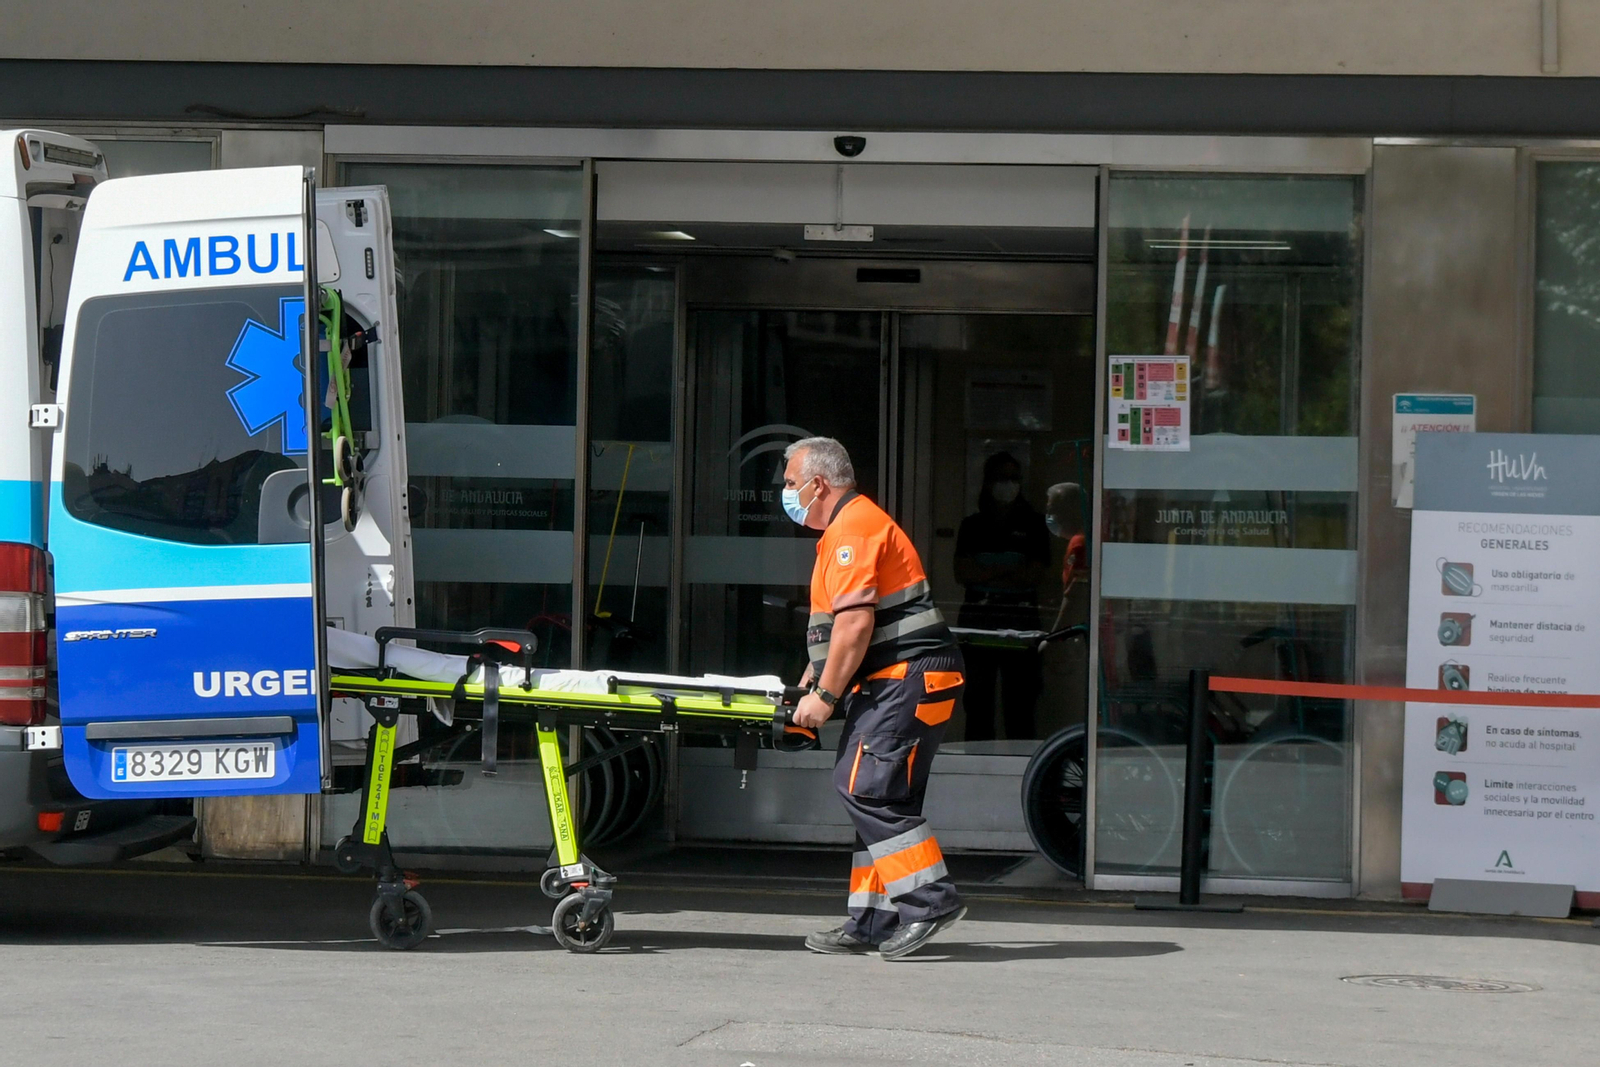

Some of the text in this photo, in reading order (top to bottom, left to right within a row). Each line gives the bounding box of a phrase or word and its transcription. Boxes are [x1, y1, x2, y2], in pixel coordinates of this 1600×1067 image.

[122, 232, 304, 282] AMBUL
[722, 489, 774, 502] JUNTA DE
[1155, 509, 1194, 524] JUNTA
[1200, 510, 1215, 524] DE
[1227, 526, 1239, 536] de
[1242, 526, 1270, 536] Salud
[1458, 522, 1573, 537] RECOMENDACIONES
[1480, 538, 1549, 551] GENERALES
[1491, 569, 1574, 581] Uso obligatorio de
[1491, 584, 1539, 593] mascarilla
[1490, 620, 1586, 632] Mantener distacia de
[63, 628, 157, 642] SPRINTER
[1489, 633, 1534, 644] seguridad
[193, 669, 317, 697] URGE
[1488, 673, 1566, 685] Realice frecuente
[1486, 725, 1498, 735] En
[1500, 727, 1521, 736] caso
[1523, 726, 1535, 737] de
[1499, 740, 1526, 750] acuda
[1528, 740, 1537, 750] al
[1539, 741, 1576, 752] hospital
[131, 746, 269, 777] 8329 KGW
[117, 768, 124, 776] E
[371, 754, 386, 821] TGE 241 M
[1516, 781, 1577, 793] interacciones
[1484, 793, 1585, 806] sociales y la movilidad
[1484, 807, 1595, 821] innecesaria por el centro
